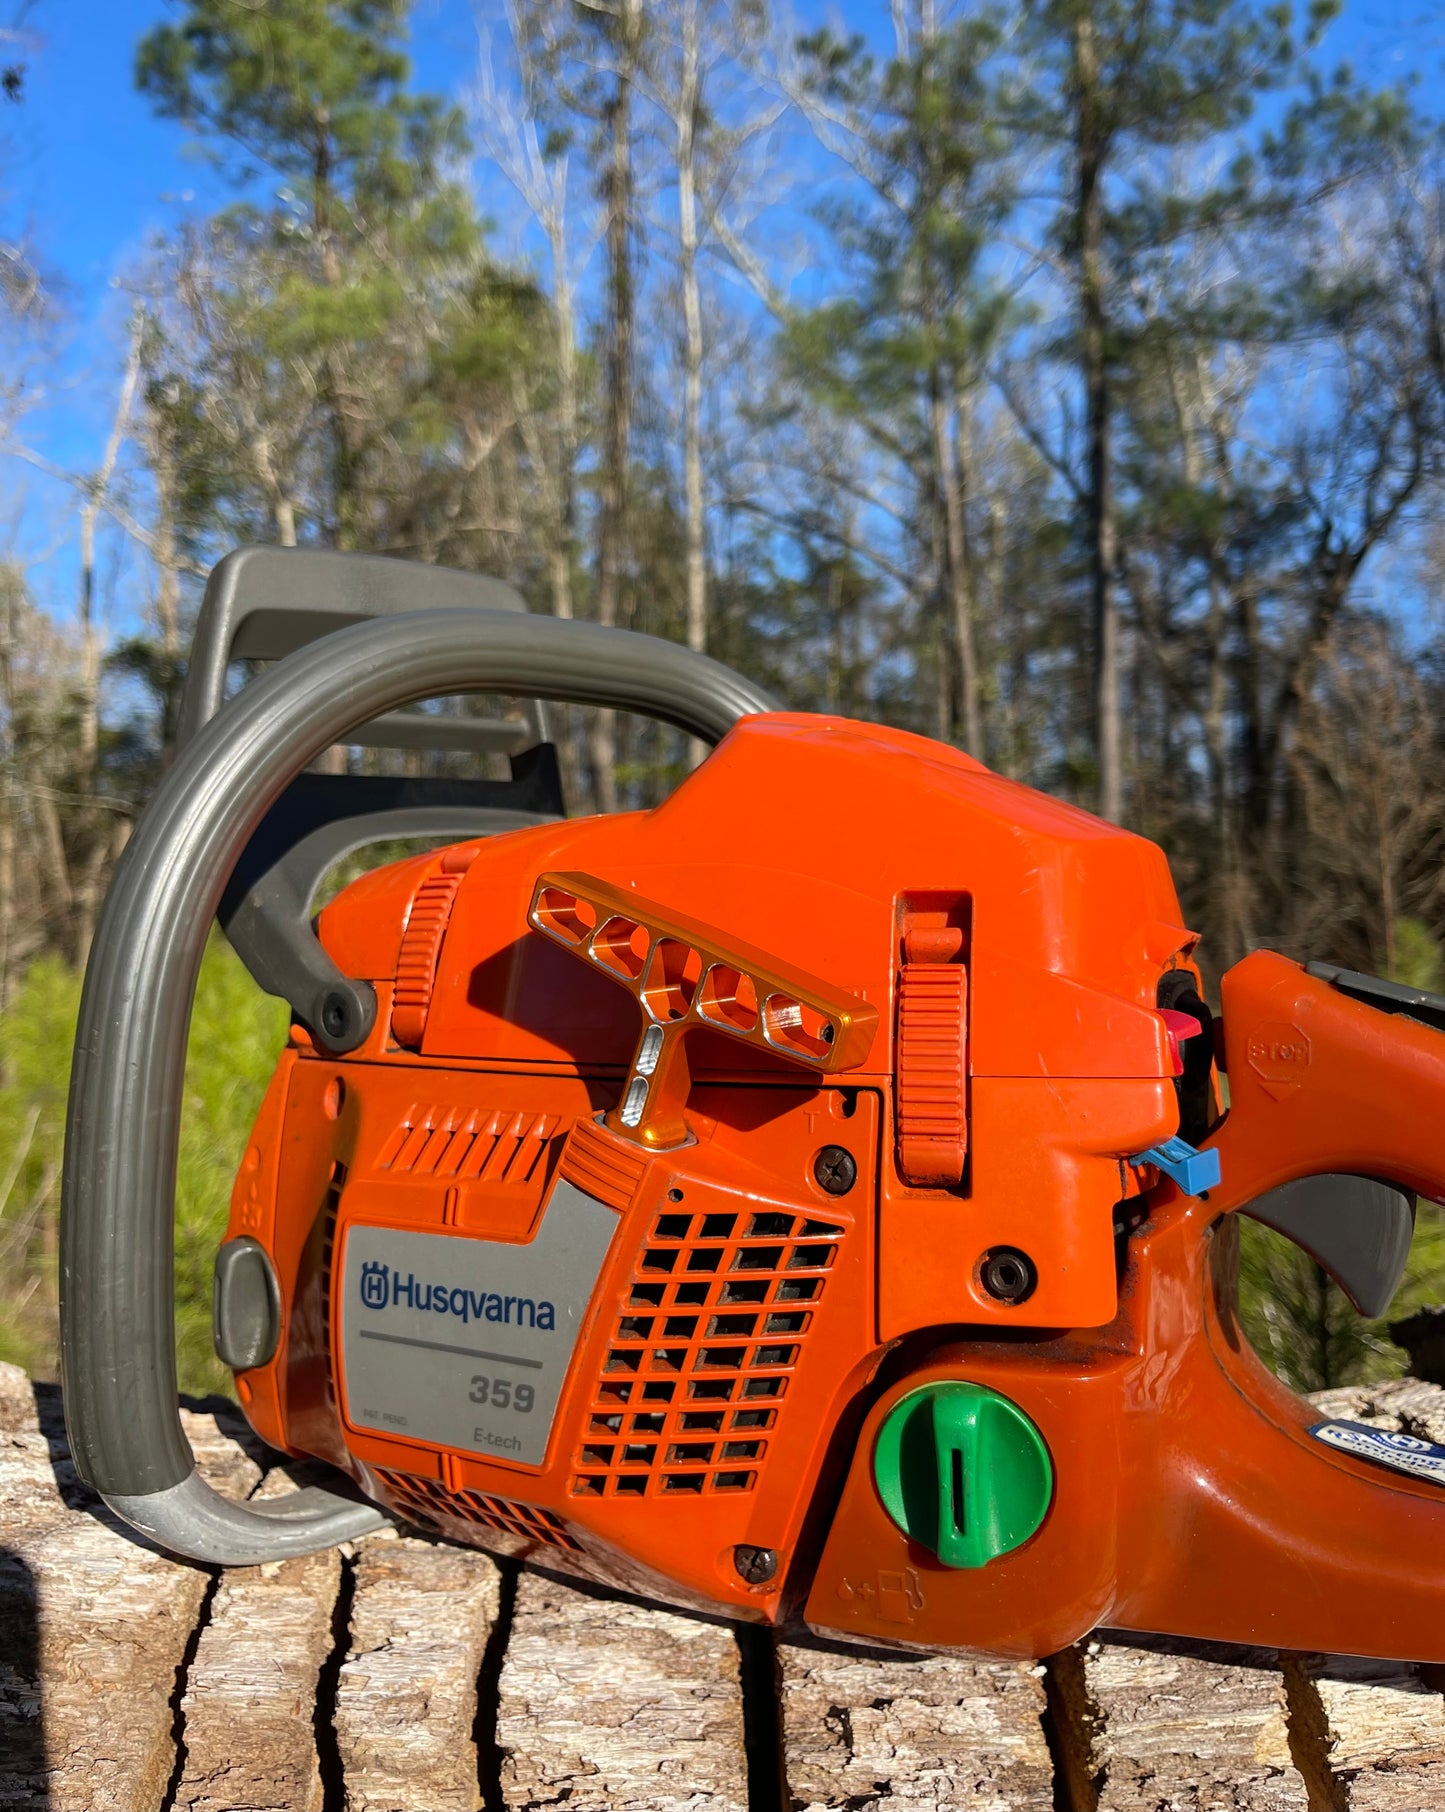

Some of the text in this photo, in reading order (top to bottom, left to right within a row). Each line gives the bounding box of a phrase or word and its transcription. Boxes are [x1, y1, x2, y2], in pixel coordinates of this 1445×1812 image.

[1250, 1042, 1308, 1062] STOP
[393, 1272, 555, 1330] Husqvarna
[468, 1375, 535, 1413] 359
[473, 1427, 522, 1451] E-tech
